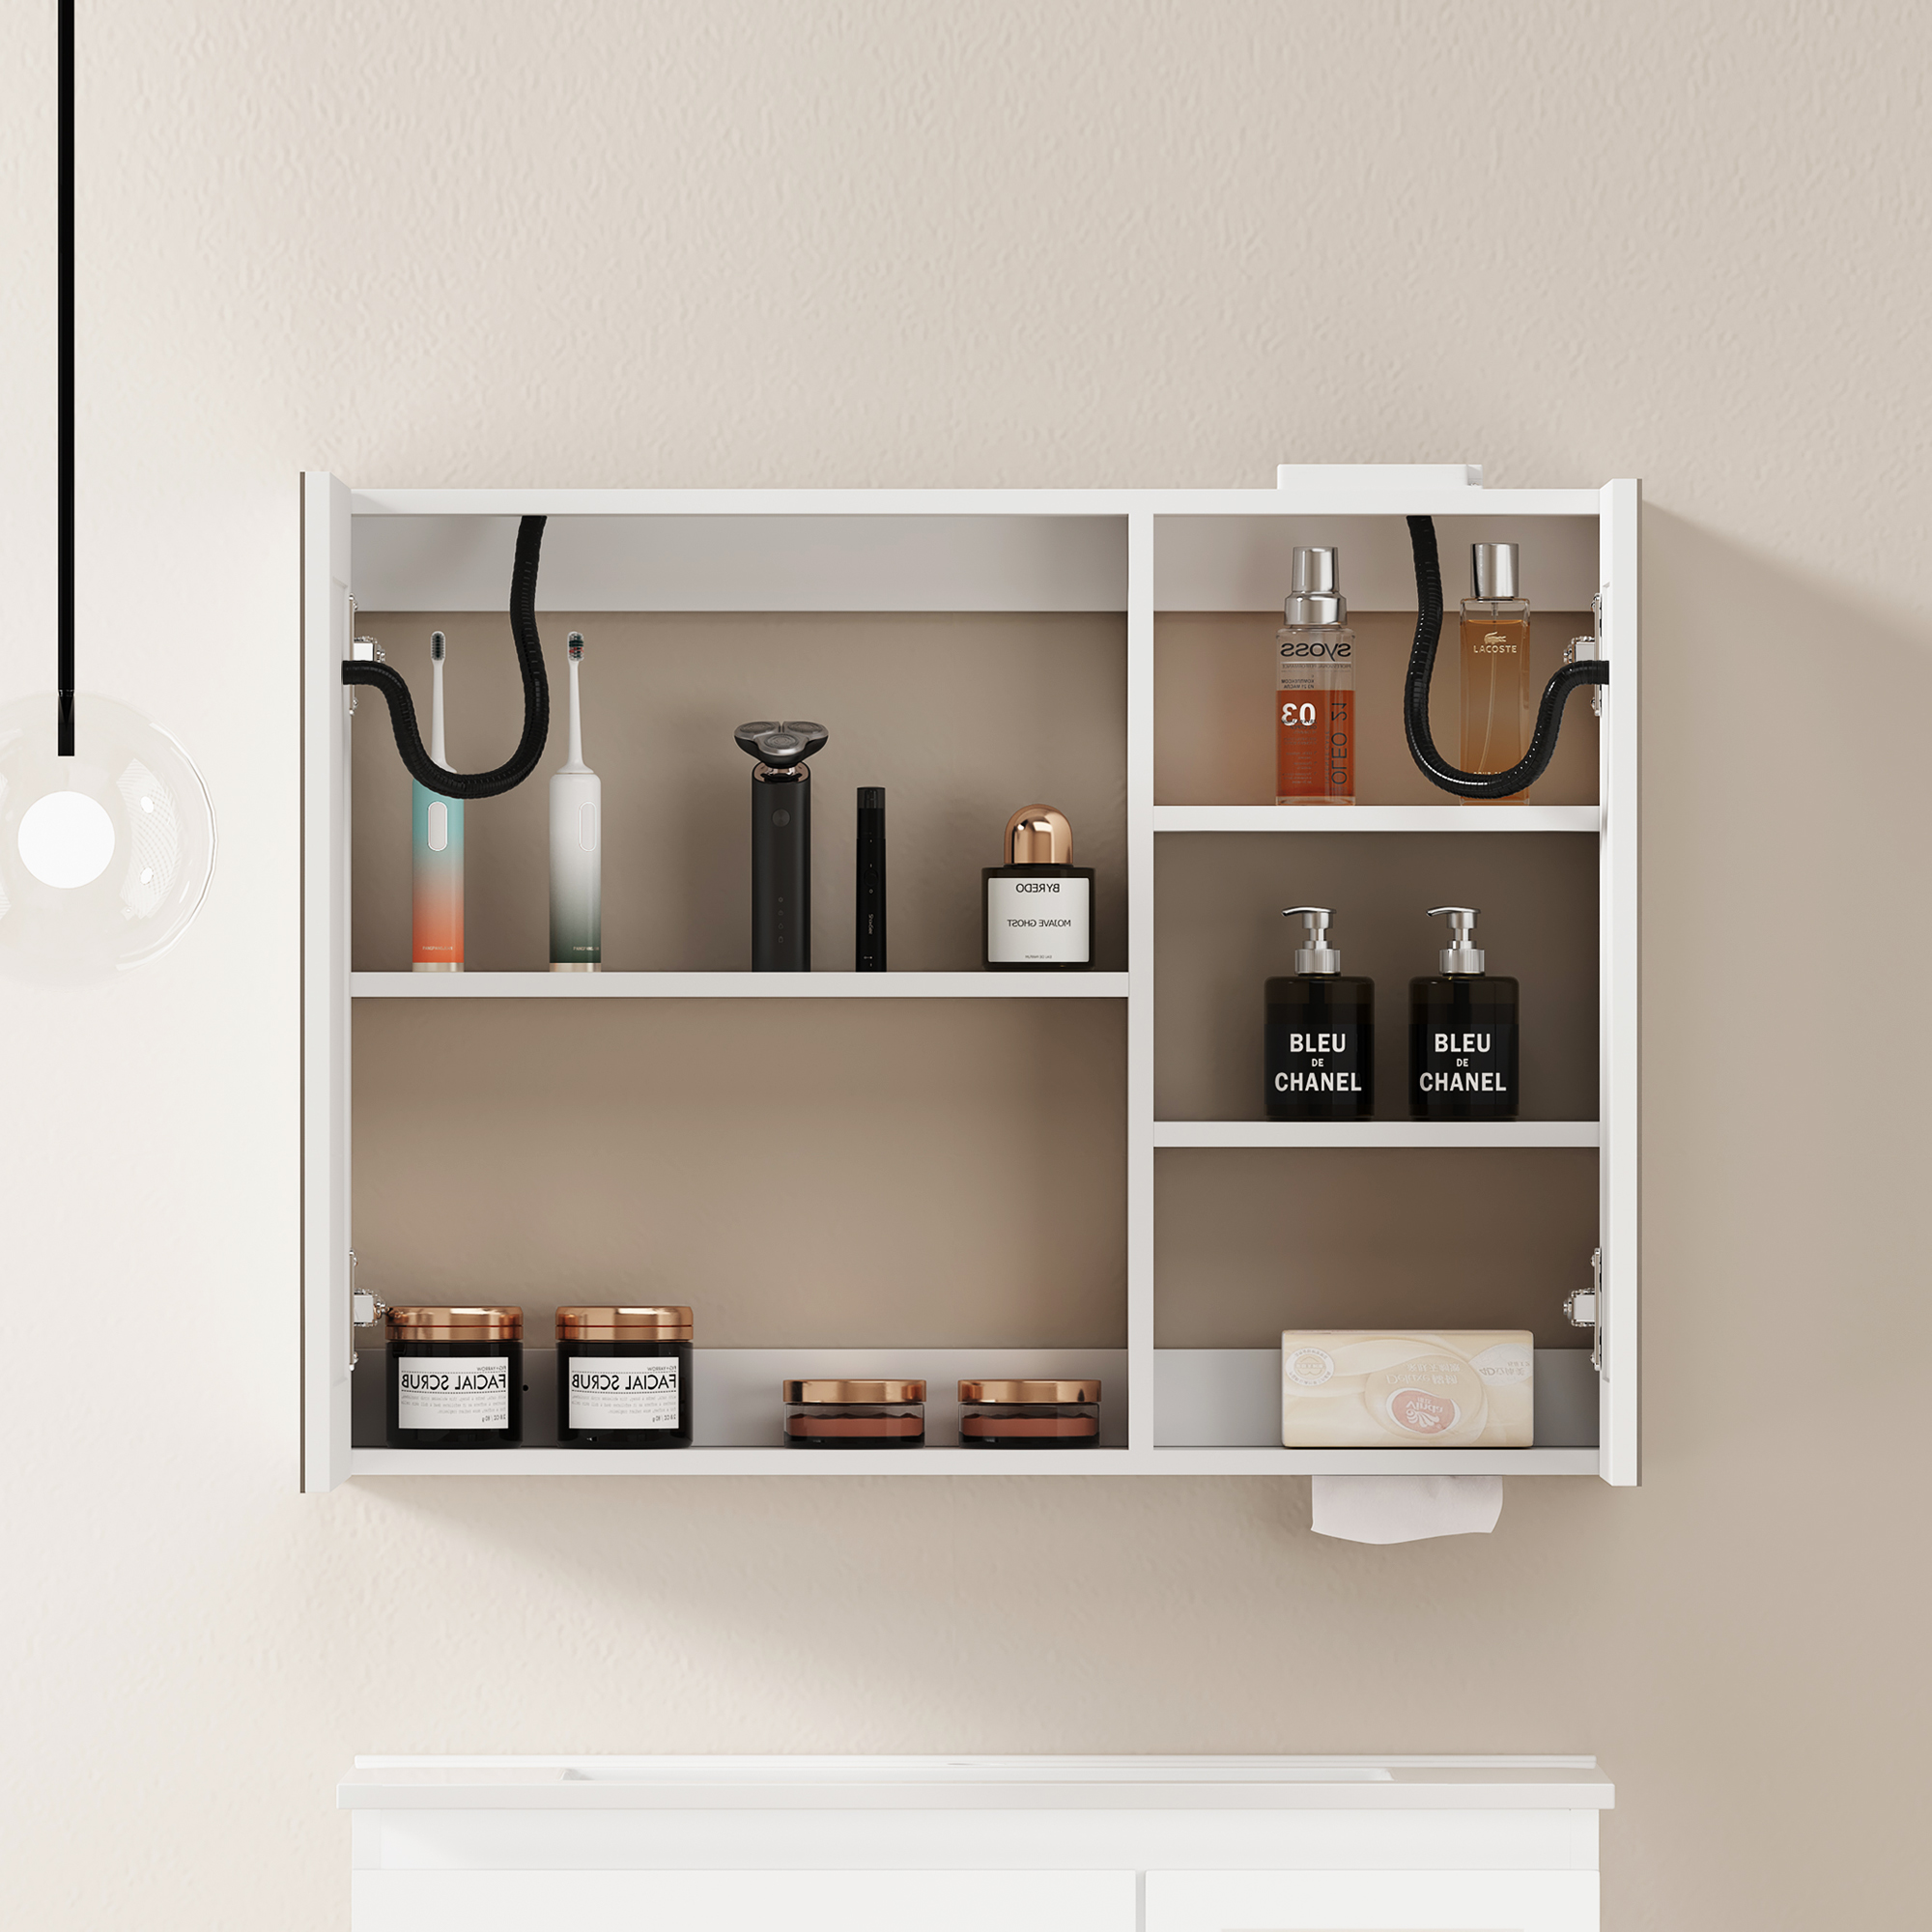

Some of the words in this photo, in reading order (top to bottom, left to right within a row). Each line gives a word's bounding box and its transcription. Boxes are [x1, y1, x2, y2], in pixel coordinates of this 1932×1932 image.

[1473, 644, 1517, 654] LACOSTE
[1290, 1033, 1346, 1052] BLEU
[1435, 1033, 1491, 1052] BLEU
[1311, 1058, 1324, 1067] DE
[1456, 1058, 1469, 1067] DE
[1274, 1072, 1362, 1092] CHANEL
[1419, 1072, 1507, 1092] CHANEL
